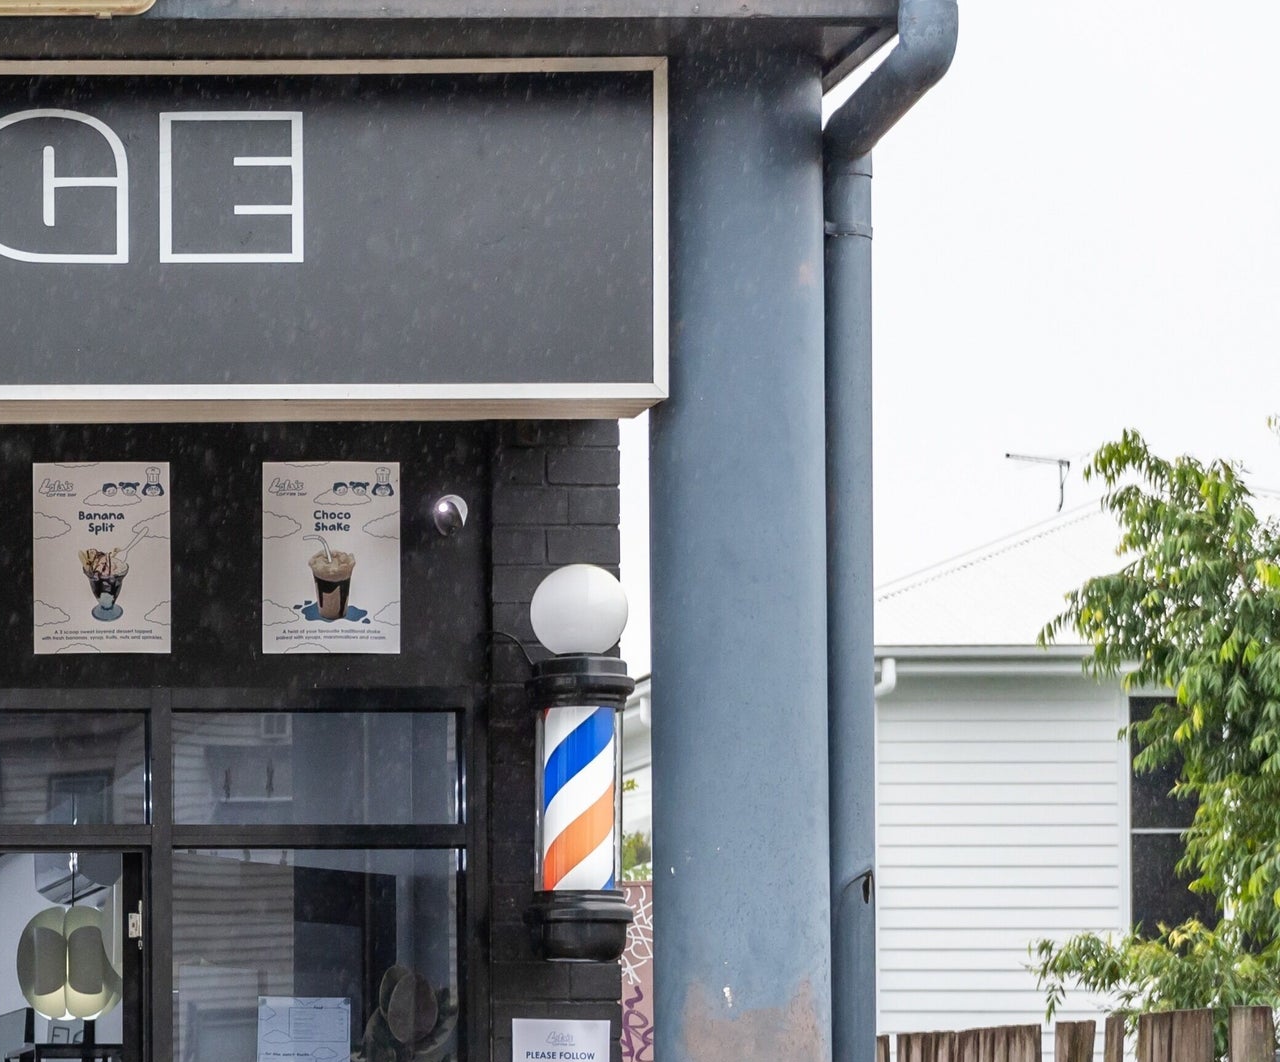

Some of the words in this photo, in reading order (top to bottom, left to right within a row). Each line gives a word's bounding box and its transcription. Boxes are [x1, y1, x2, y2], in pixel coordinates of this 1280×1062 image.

[78, 510, 125, 521] Banana
[313, 510, 352, 520] Choco
[88, 522, 115, 535] Split
[314, 521, 351, 532] Shake
[526, 1051, 557, 1060] PLEASE
[559, 1051, 596, 1061] FOLLOW
